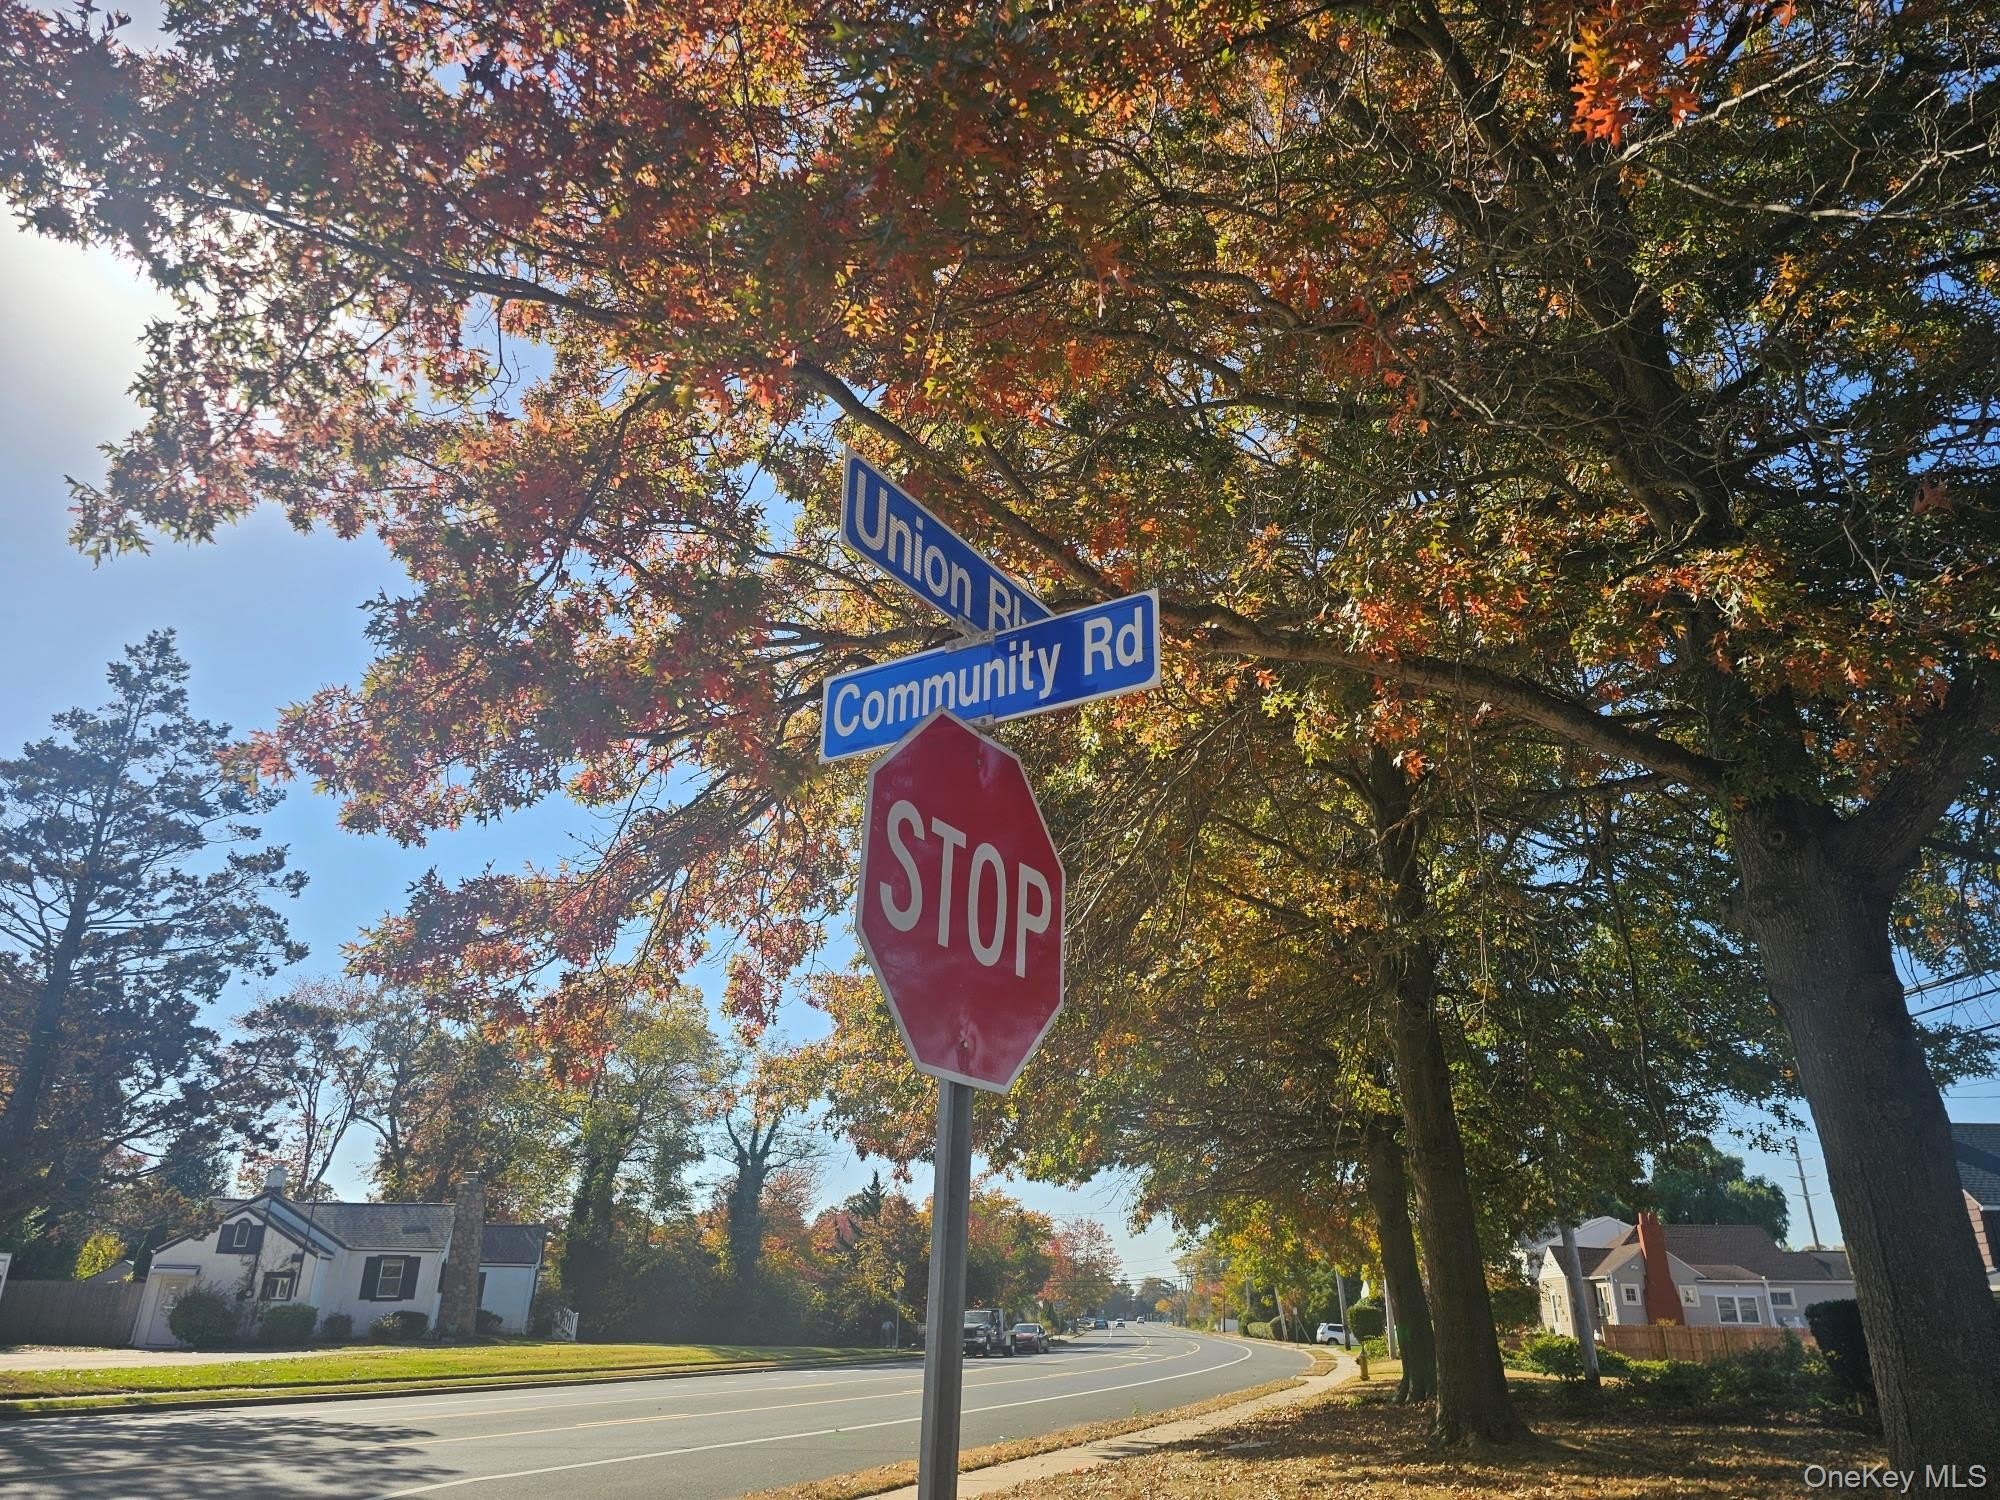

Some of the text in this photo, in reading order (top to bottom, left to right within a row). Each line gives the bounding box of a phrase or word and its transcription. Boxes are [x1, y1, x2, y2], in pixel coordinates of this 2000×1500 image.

[855, 469, 1027, 631] Union Bl
[833, 607, 1144, 736] Community Rd
[880, 800, 1051, 978] STOP
